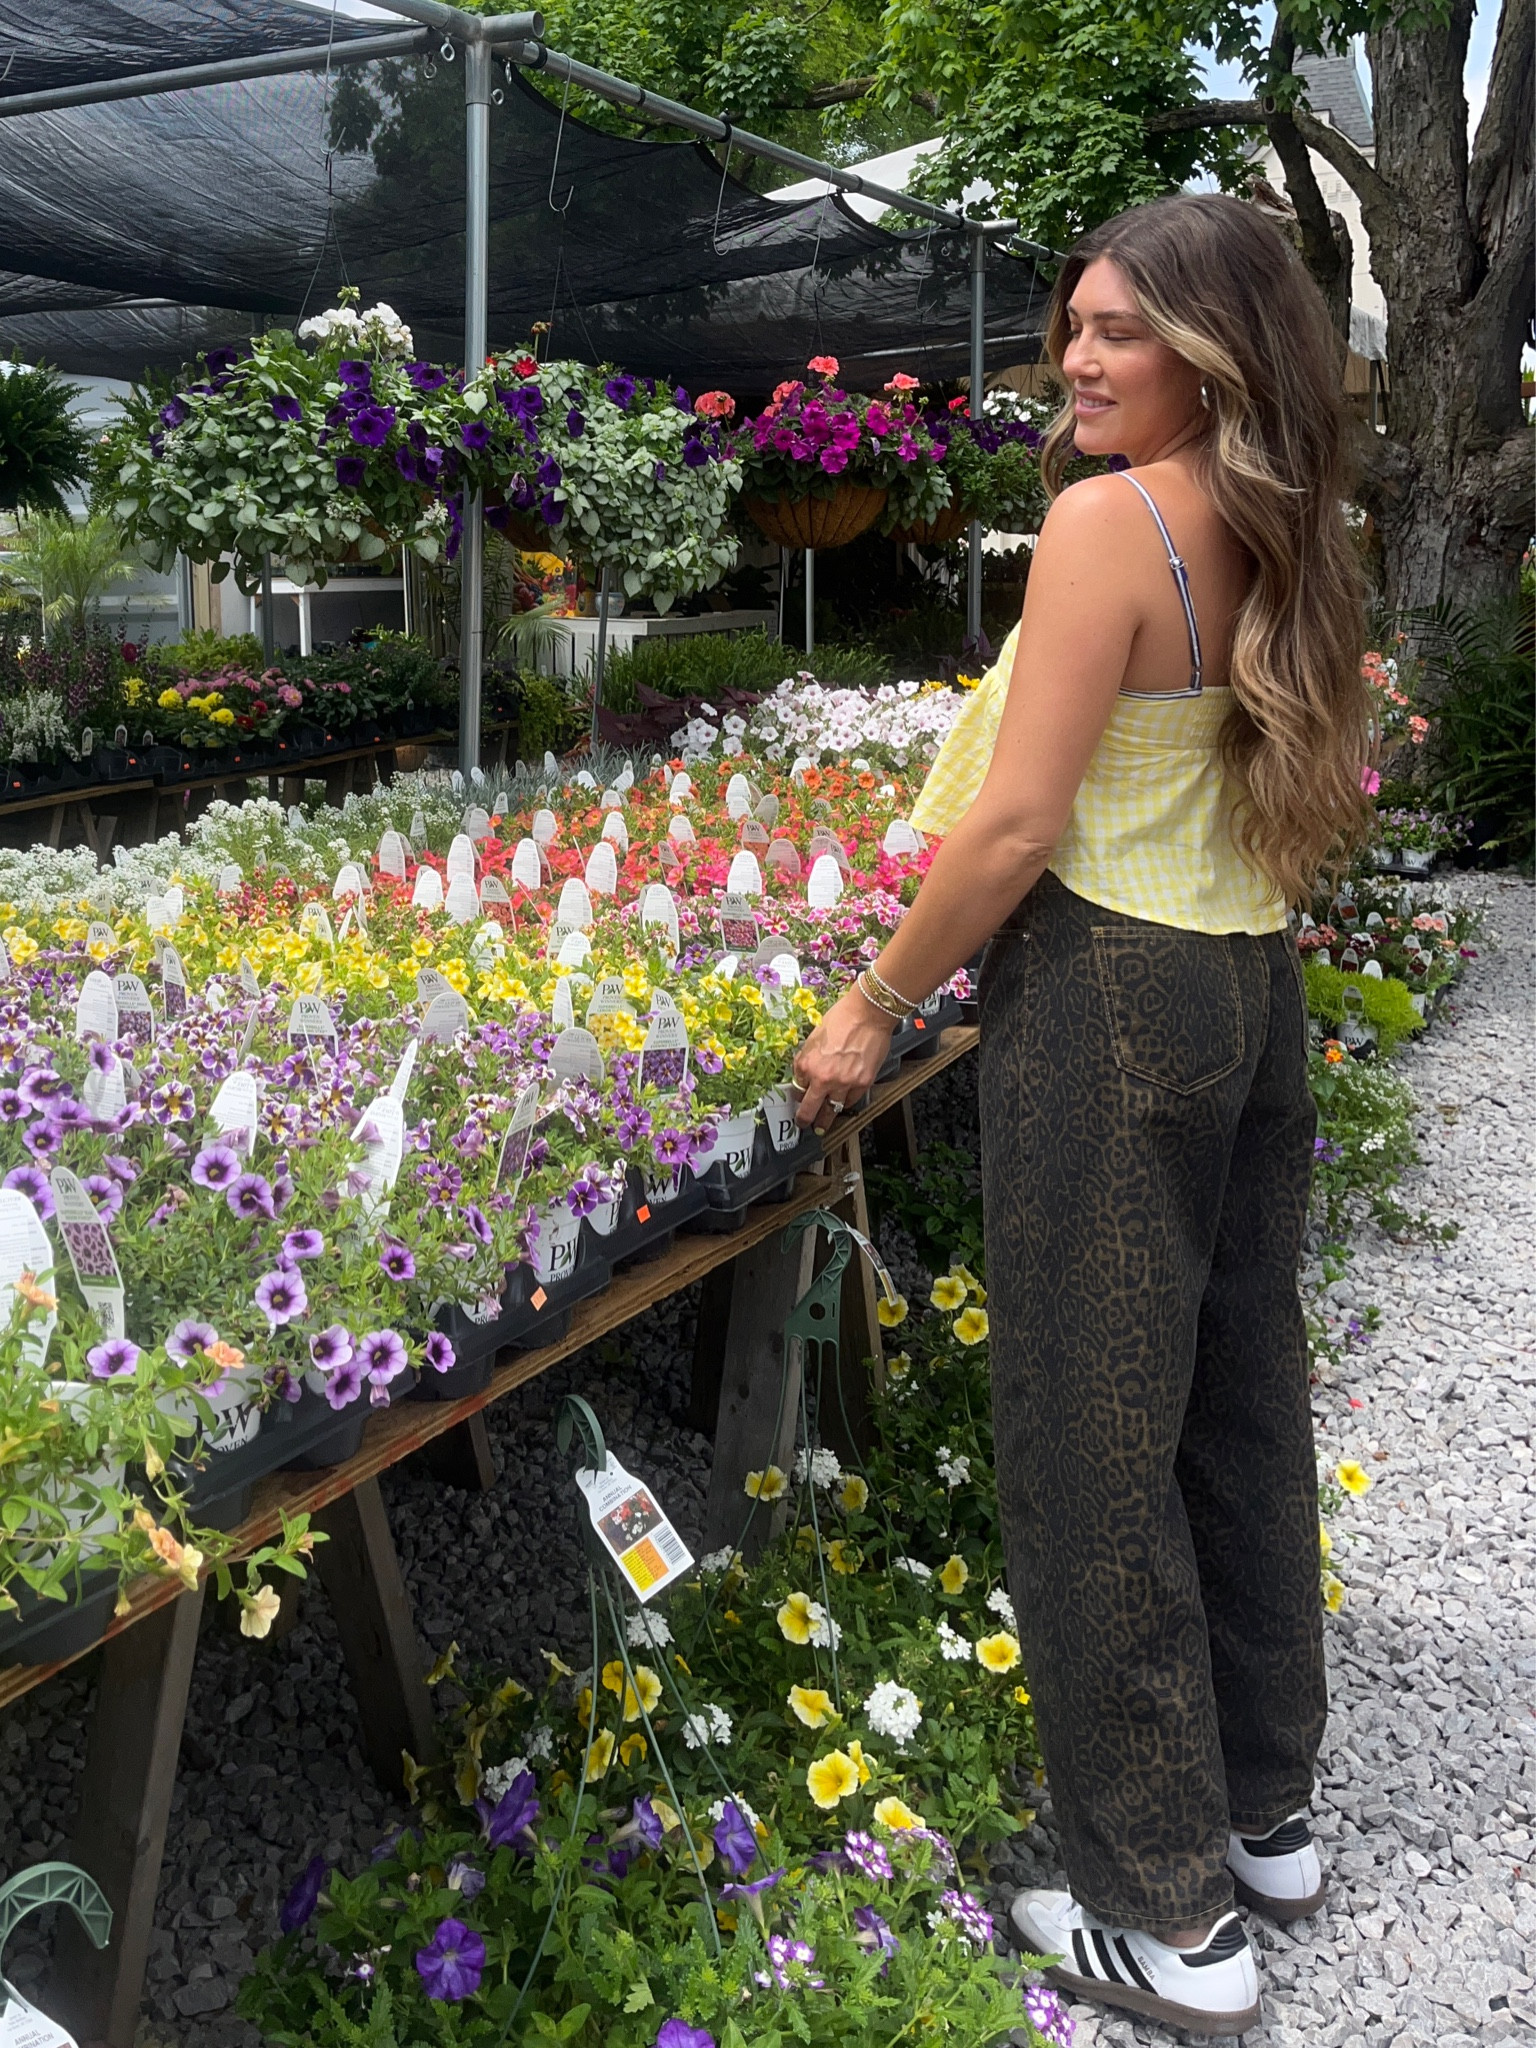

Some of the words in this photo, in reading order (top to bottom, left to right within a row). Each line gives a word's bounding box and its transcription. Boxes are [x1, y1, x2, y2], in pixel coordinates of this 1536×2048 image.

[117, 980, 140, 992] PW
[420, 973, 439, 985] PW
[602, 983, 625, 995] PW
[299, 1001, 321, 1014] PW
[658, 1016, 681, 1029] PW
[778, 1119, 798, 1143] P
[55, 1177, 77, 1194] PW
[548, 1238, 579, 1273] PW
[598, 1485, 632, 1511] COMBINATION
[602, 1485, 622, 1503] ANNUAL
[1137, 1955, 1156, 1982] SAMBA
[15, 2030, 42, 2045] ANNUAL
